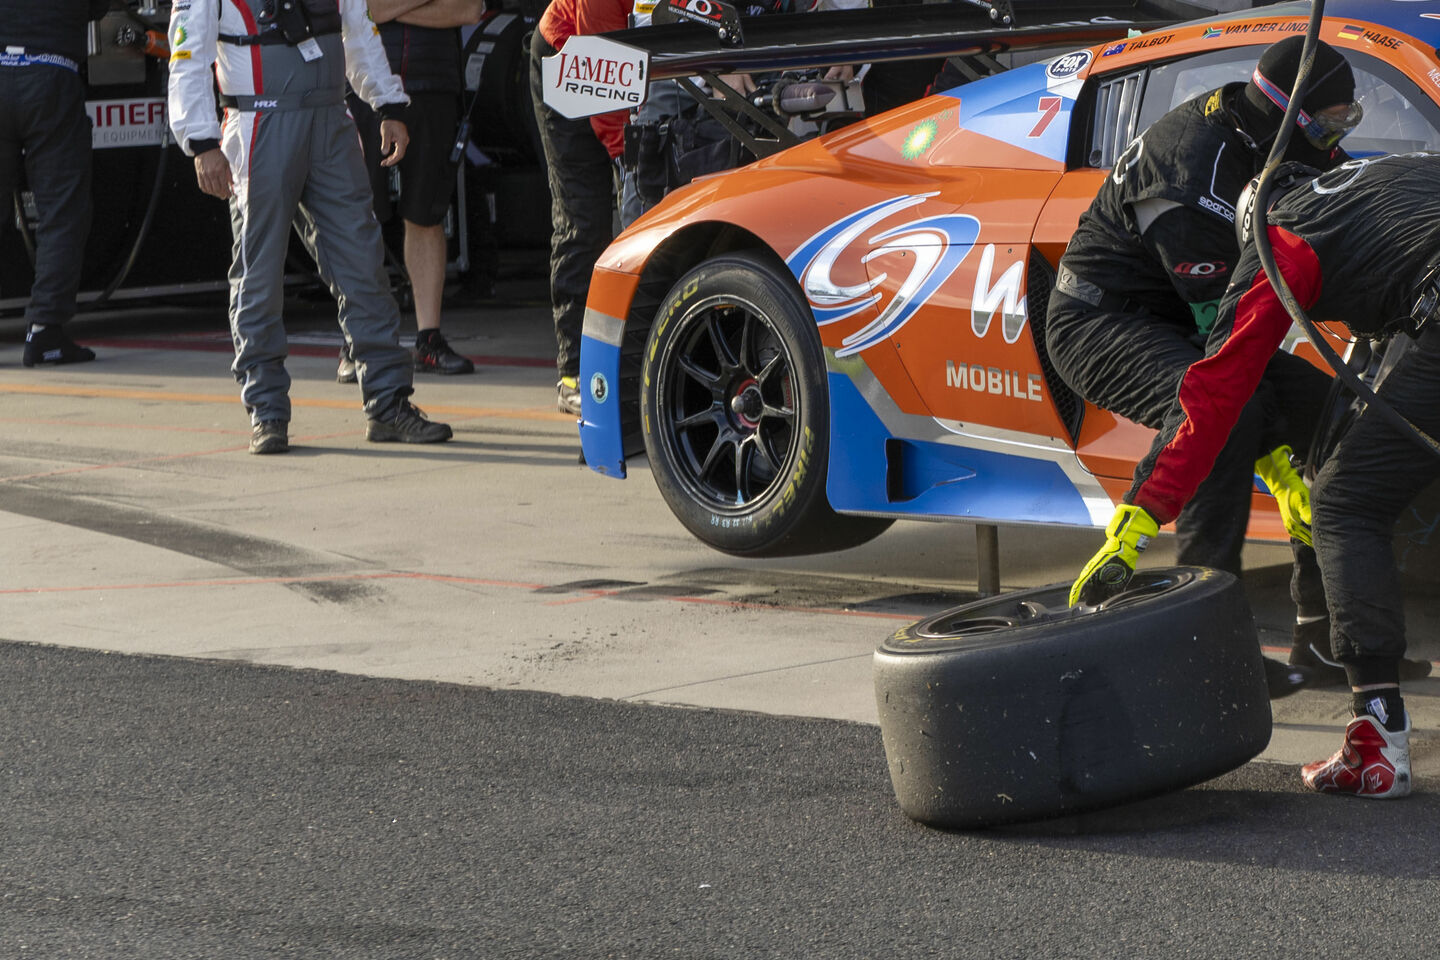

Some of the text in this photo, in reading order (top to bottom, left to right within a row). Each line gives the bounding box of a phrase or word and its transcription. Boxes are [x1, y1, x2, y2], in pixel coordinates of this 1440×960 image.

[1225, 22, 1309, 35] VAN DER LIND
[1128, 34, 1175, 51] TALBOT
[1362, 30, 1404, 50] HAASE
[556, 53, 634, 88] JAMEC
[1057, 54, 1086, 69] FOX
[565, 82, 640, 103] RACING
[254, 100, 278, 108] HRX
[93, 102, 167, 130] INER
[1027, 96, 1062, 138] 7
[103, 130, 168, 142] EQUIPMEN
[1199, 196, 1236, 221] sparco
[971, 243, 1028, 344] W
[946, 360, 1042, 402] MOBILE
